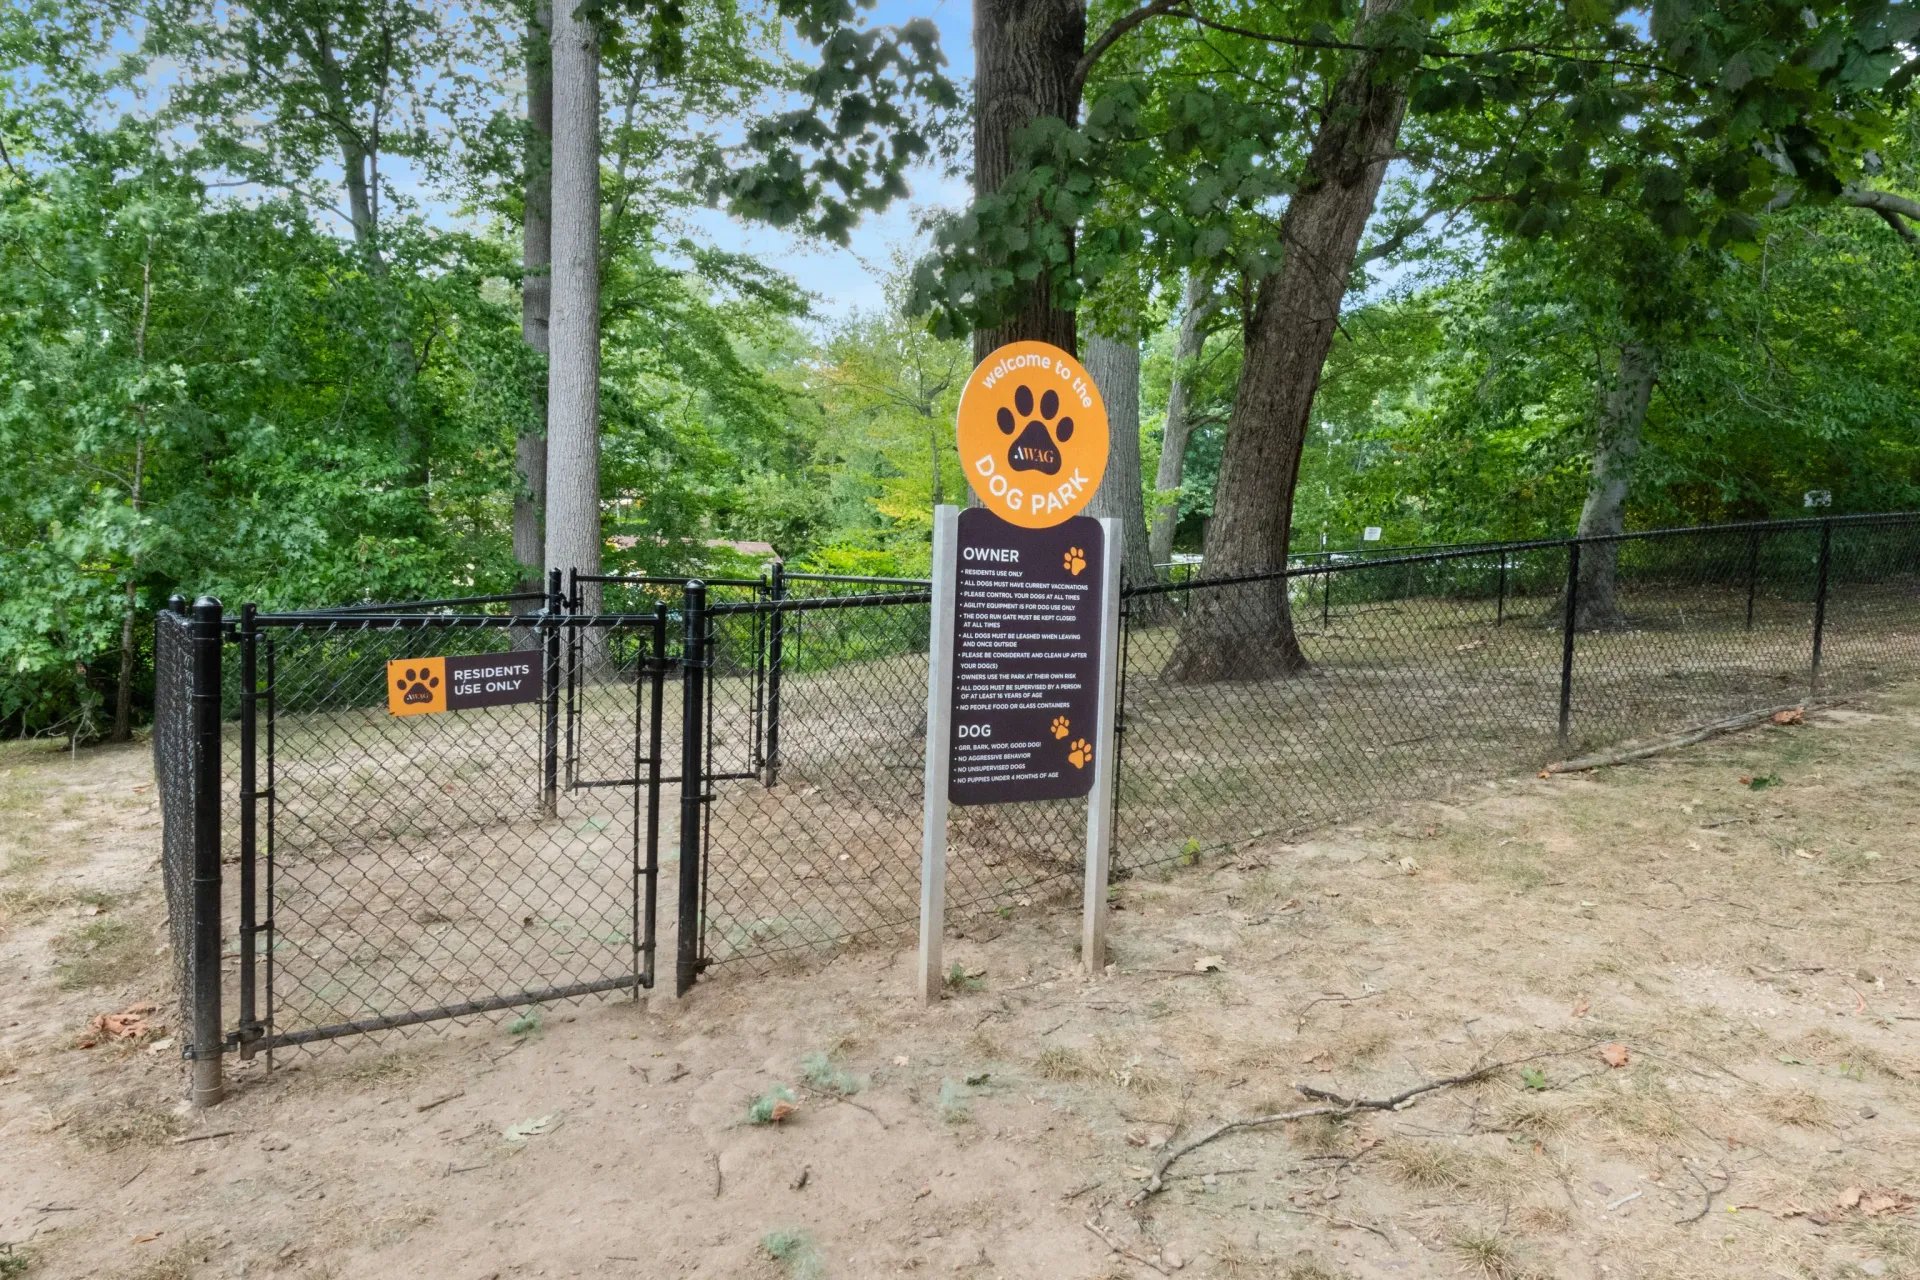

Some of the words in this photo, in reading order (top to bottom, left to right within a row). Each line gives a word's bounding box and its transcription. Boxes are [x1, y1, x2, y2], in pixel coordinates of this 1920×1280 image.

[982, 354, 1051, 389] welcome
[1055, 360, 1071, 379] to
[1072, 378, 1092, 408] the
[975, 455, 1023, 510] DOG
[1032, 468, 1089, 515] PARK
[963, 547, 1019, 562] OWNER
[454, 665, 530, 680] RESIDENTS
[455, 684, 481, 695] USE
[486, 680, 521, 692] ONLY
[958, 724, 991, 738] DOG
